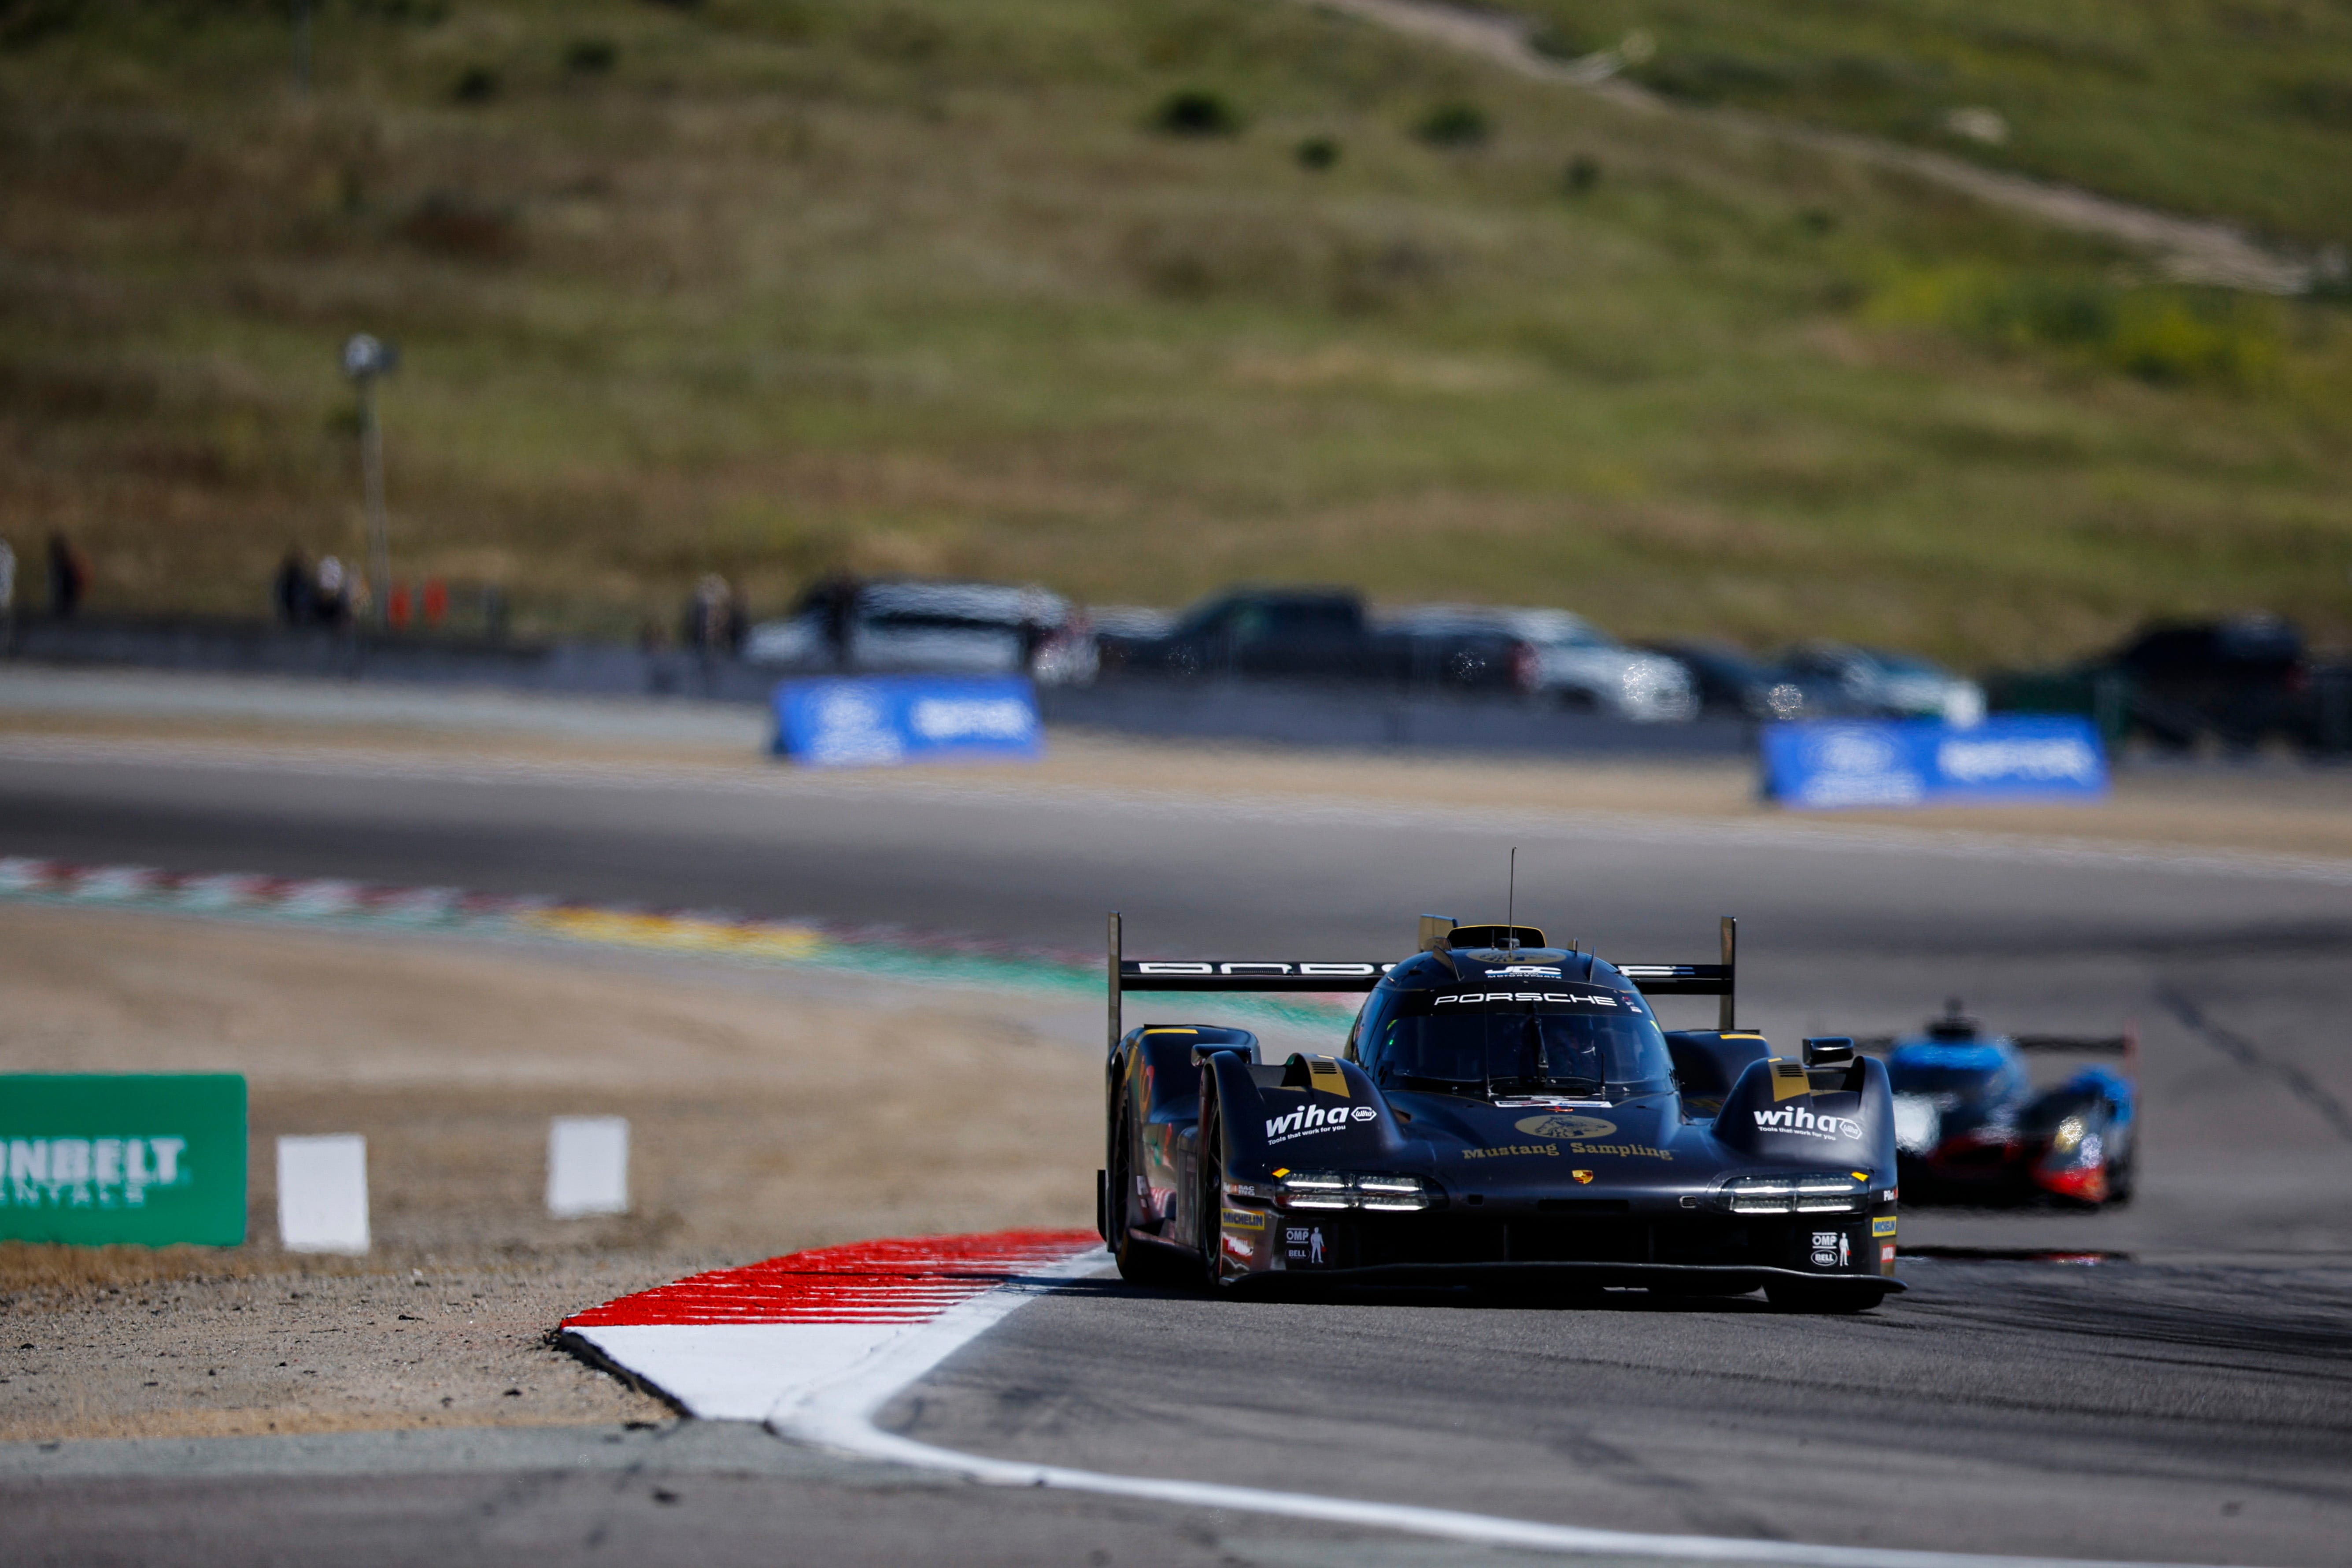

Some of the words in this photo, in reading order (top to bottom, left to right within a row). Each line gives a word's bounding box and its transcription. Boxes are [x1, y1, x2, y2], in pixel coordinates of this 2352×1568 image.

[1434, 993, 1617, 1006] PORSCHE
[1266, 1104, 1350, 1138] wiha
[1753, 1106, 1837, 1133] wiha
[1268, 1136, 1287, 1146] Tools
[1462, 1143, 1560, 1159] Mustang
[1570, 1142, 1673, 1161] Sampling
[0, 1138, 187, 1186] NBELT
[1223, 1212, 1263, 1227] MICHELIN
[1286, 1231, 1309, 1241] OMP
[1812, 1235, 1837, 1246] OMP
